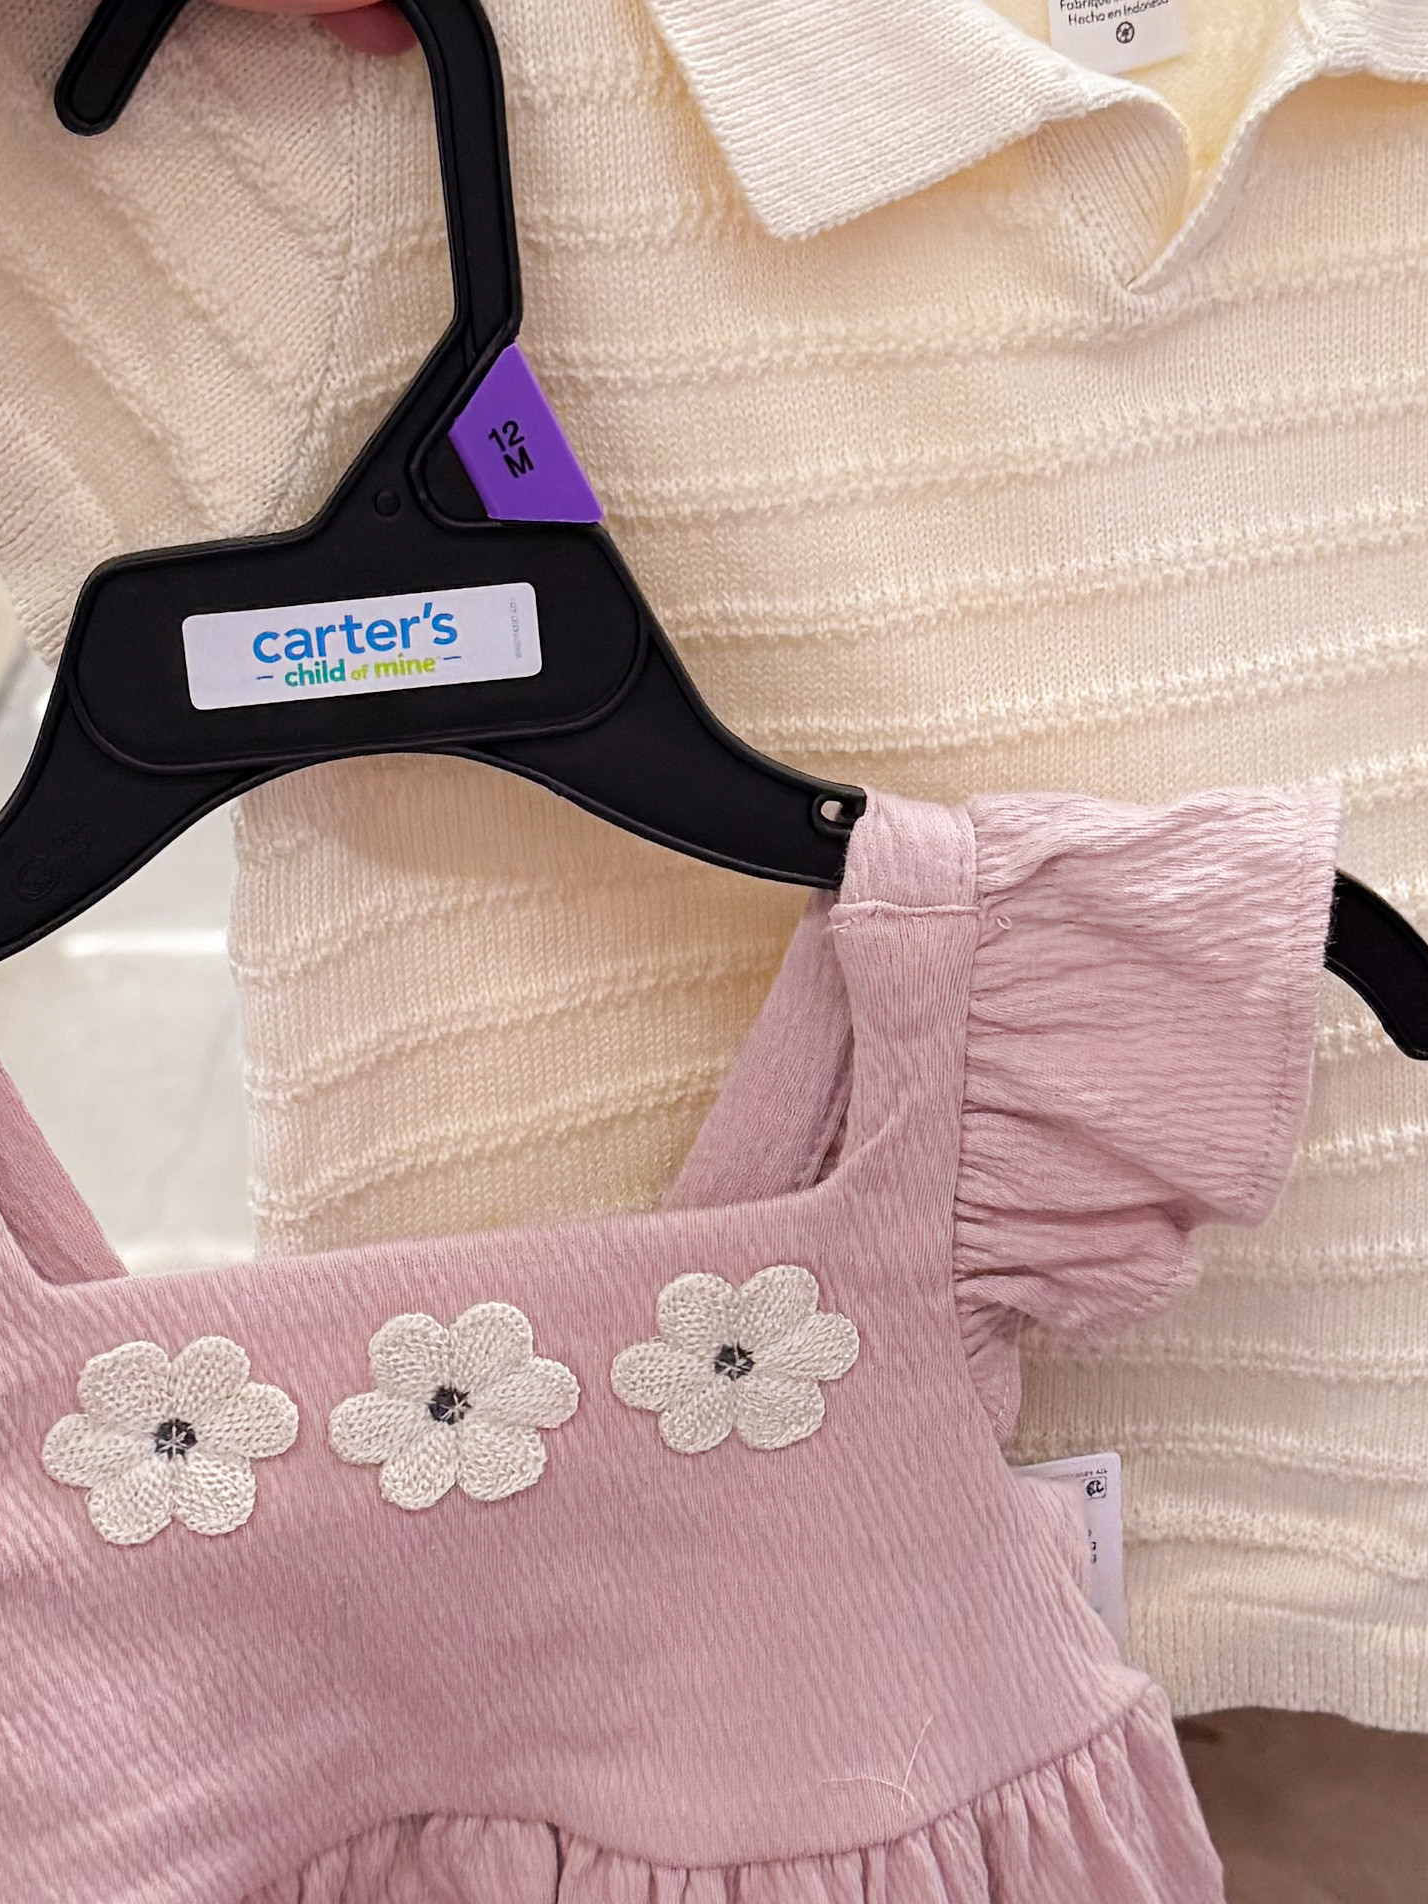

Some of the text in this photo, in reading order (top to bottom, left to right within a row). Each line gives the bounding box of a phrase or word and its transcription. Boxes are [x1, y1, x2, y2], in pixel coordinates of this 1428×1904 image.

[1068, 10, 1106, 26] Hecho
[1108, 9, 1122, 20] en
[488, 420, 526, 452] 12
[503, 447, 535, 478] M
[253, 602, 458, 663] carter's
[285, 653, 437, 687] child of mine
